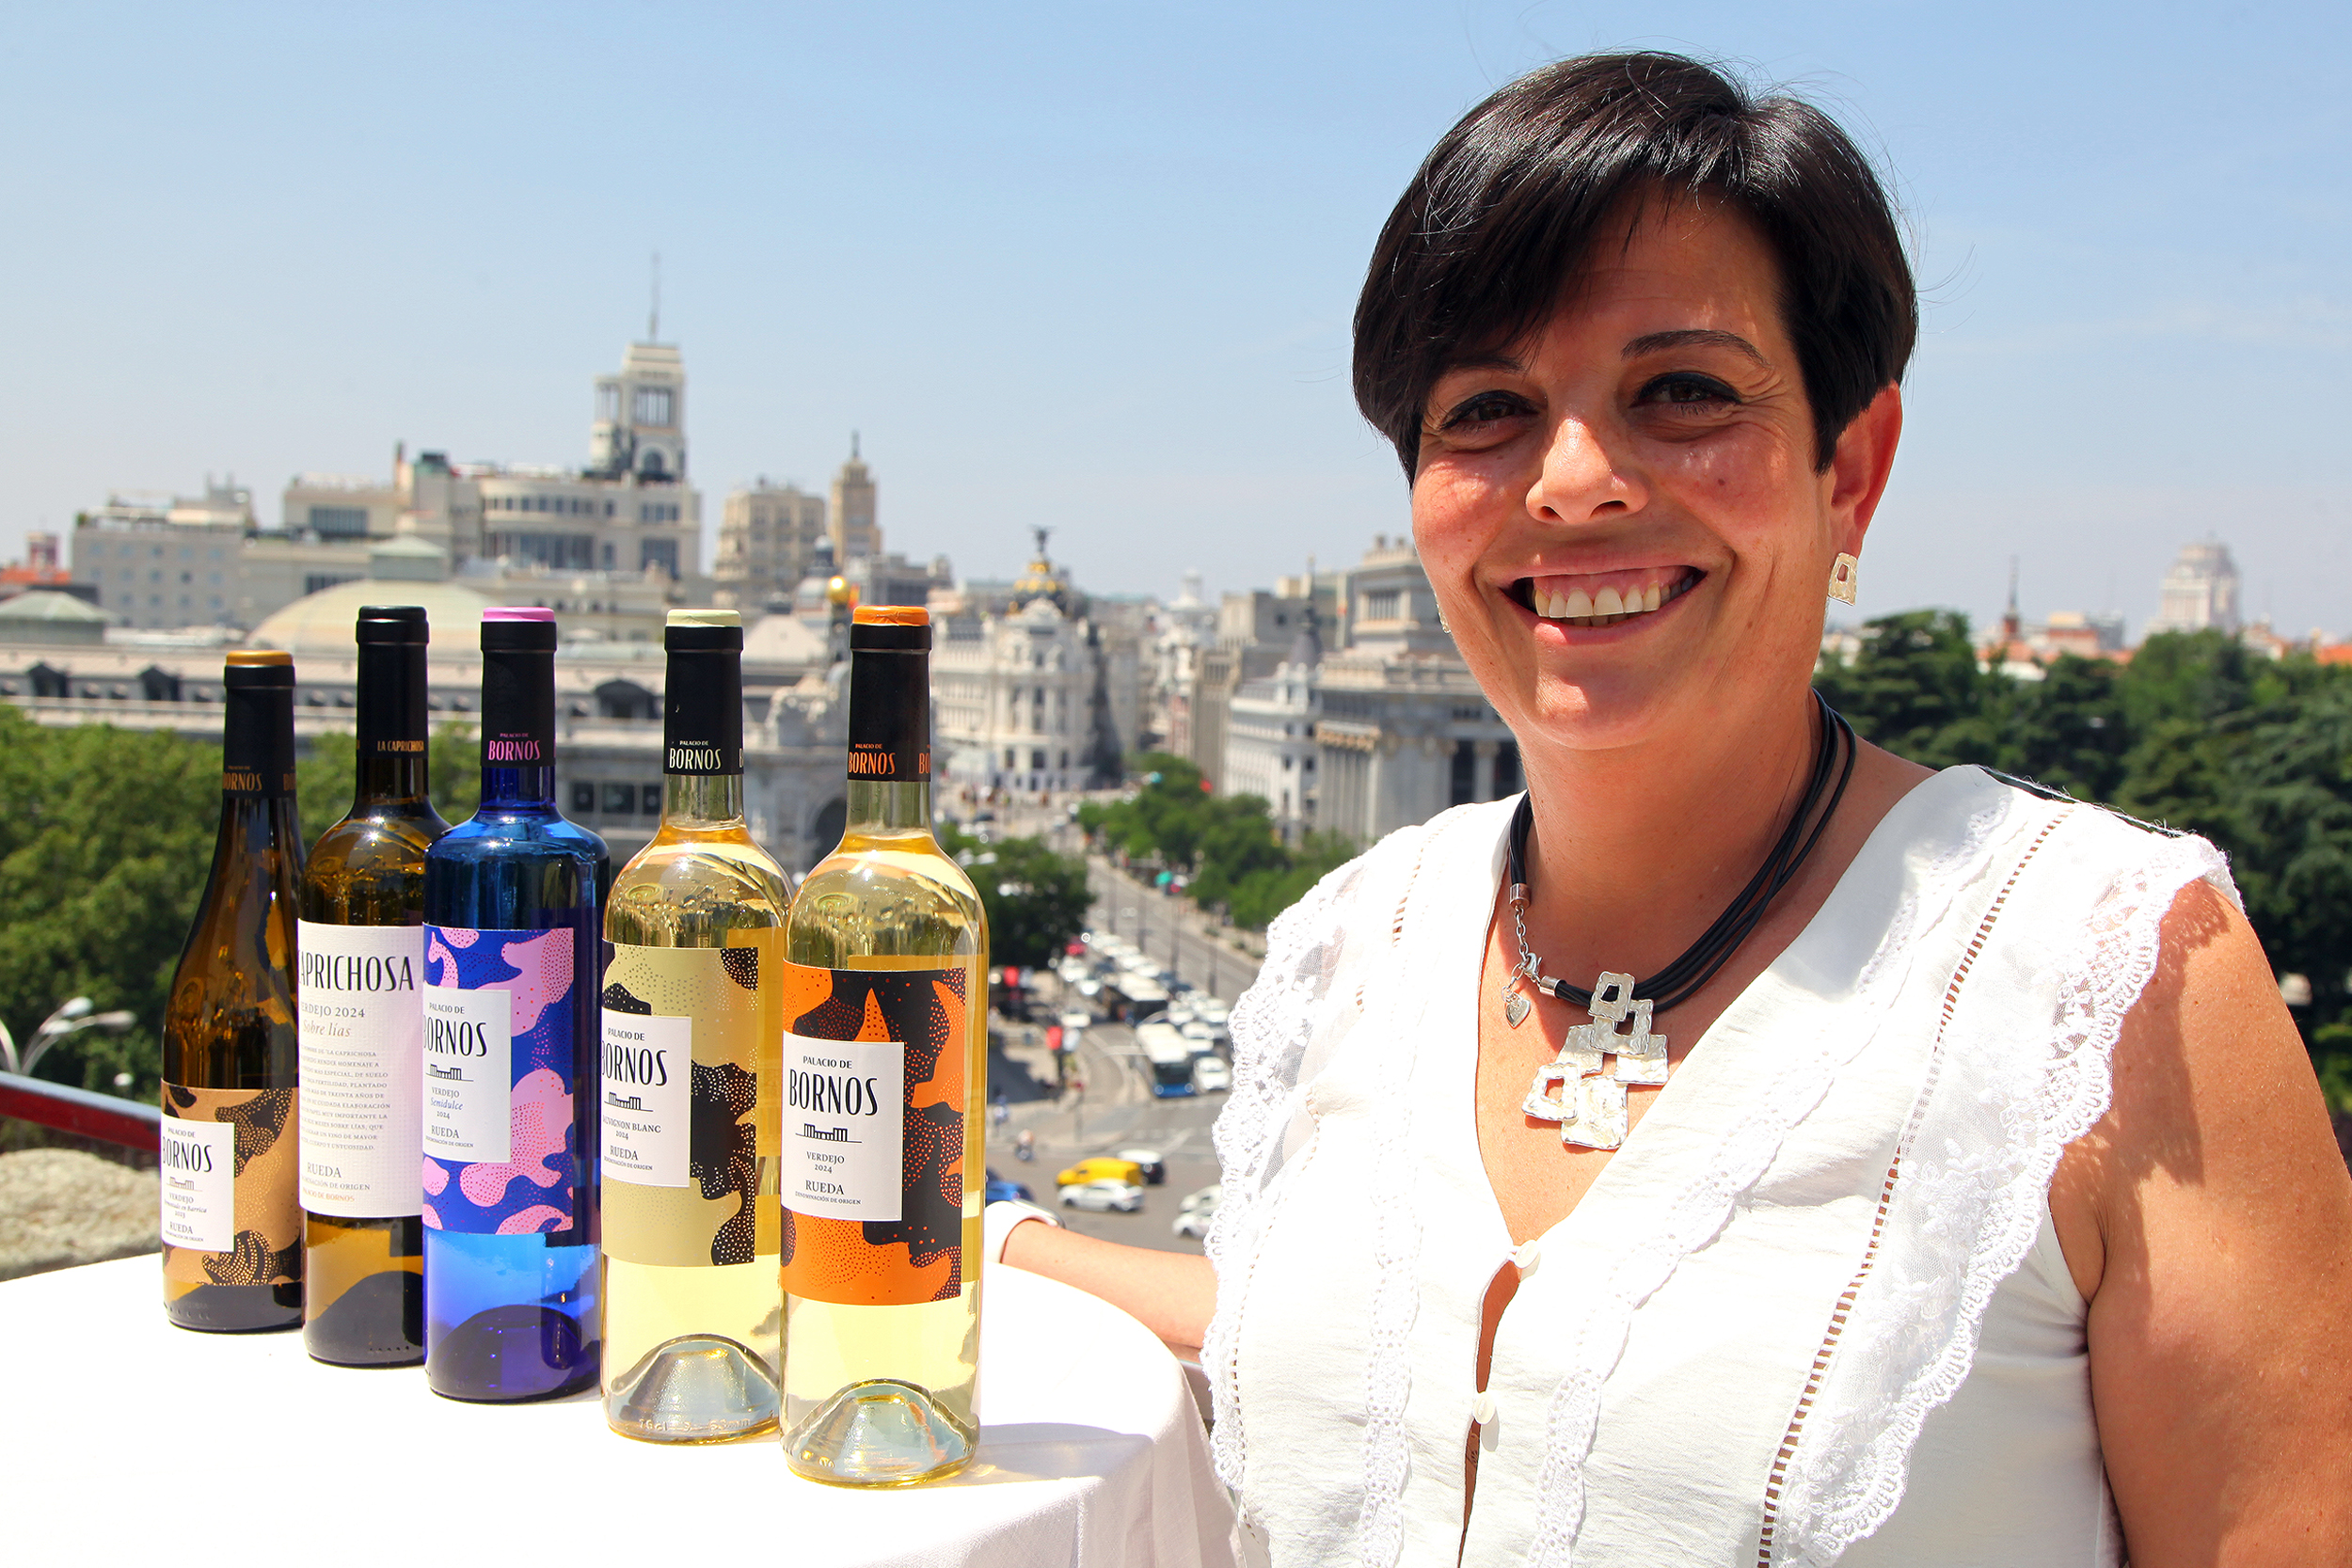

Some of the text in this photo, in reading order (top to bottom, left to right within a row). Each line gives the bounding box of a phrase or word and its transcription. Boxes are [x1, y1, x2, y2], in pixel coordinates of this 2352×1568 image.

[377, 740, 386, 752] LA
[488, 739, 541, 761] BORNOS
[669, 748, 722, 770] BORNOS
[849, 752, 896, 775] BORNOS
[299, 950, 414, 991] APRICHOSA
[301, 1002, 365, 1018] ERDEJO 2024
[429, 1002, 465, 1015] PALACIO DE
[304, 1019, 351, 1037] Sobre lías
[608, 1027, 645, 1041] PALACIO DE
[803, 1055, 852, 1069] PALACIO DE
[431, 1086, 460, 1099] VERDEJO
[789, 1069, 878, 1117] BORNOS
[430, 1097, 464, 1110] Semidulce
[437, 1111, 451, 1120] 2024
[431, 1124, 461, 1139] RUEDA
[631, 1122, 661, 1134] BLANC
[615, 1130, 629, 1141] 2024
[610, 1145, 639, 1161] RUEDA
[806, 1150, 845, 1165] VERDEJO
[308, 1162, 342, 1179] RUEDA
[633, 1163, 654, 1171] ORIGEN
[814, 1164, 833, 1175] 2024
[329, 1181, 339, 1190] DE
[340, 1182, 372, 1192] ORIGEN
[805, 1179, 845, 1196] RUEDA
[169, 1192, 195, 1204] VERDEJO
[326, 1193, 356, 1202] BORNOS
[838, 1197, 862, 1206] ORIGEN
[169, 1221, 194, 1235] RUEDA
